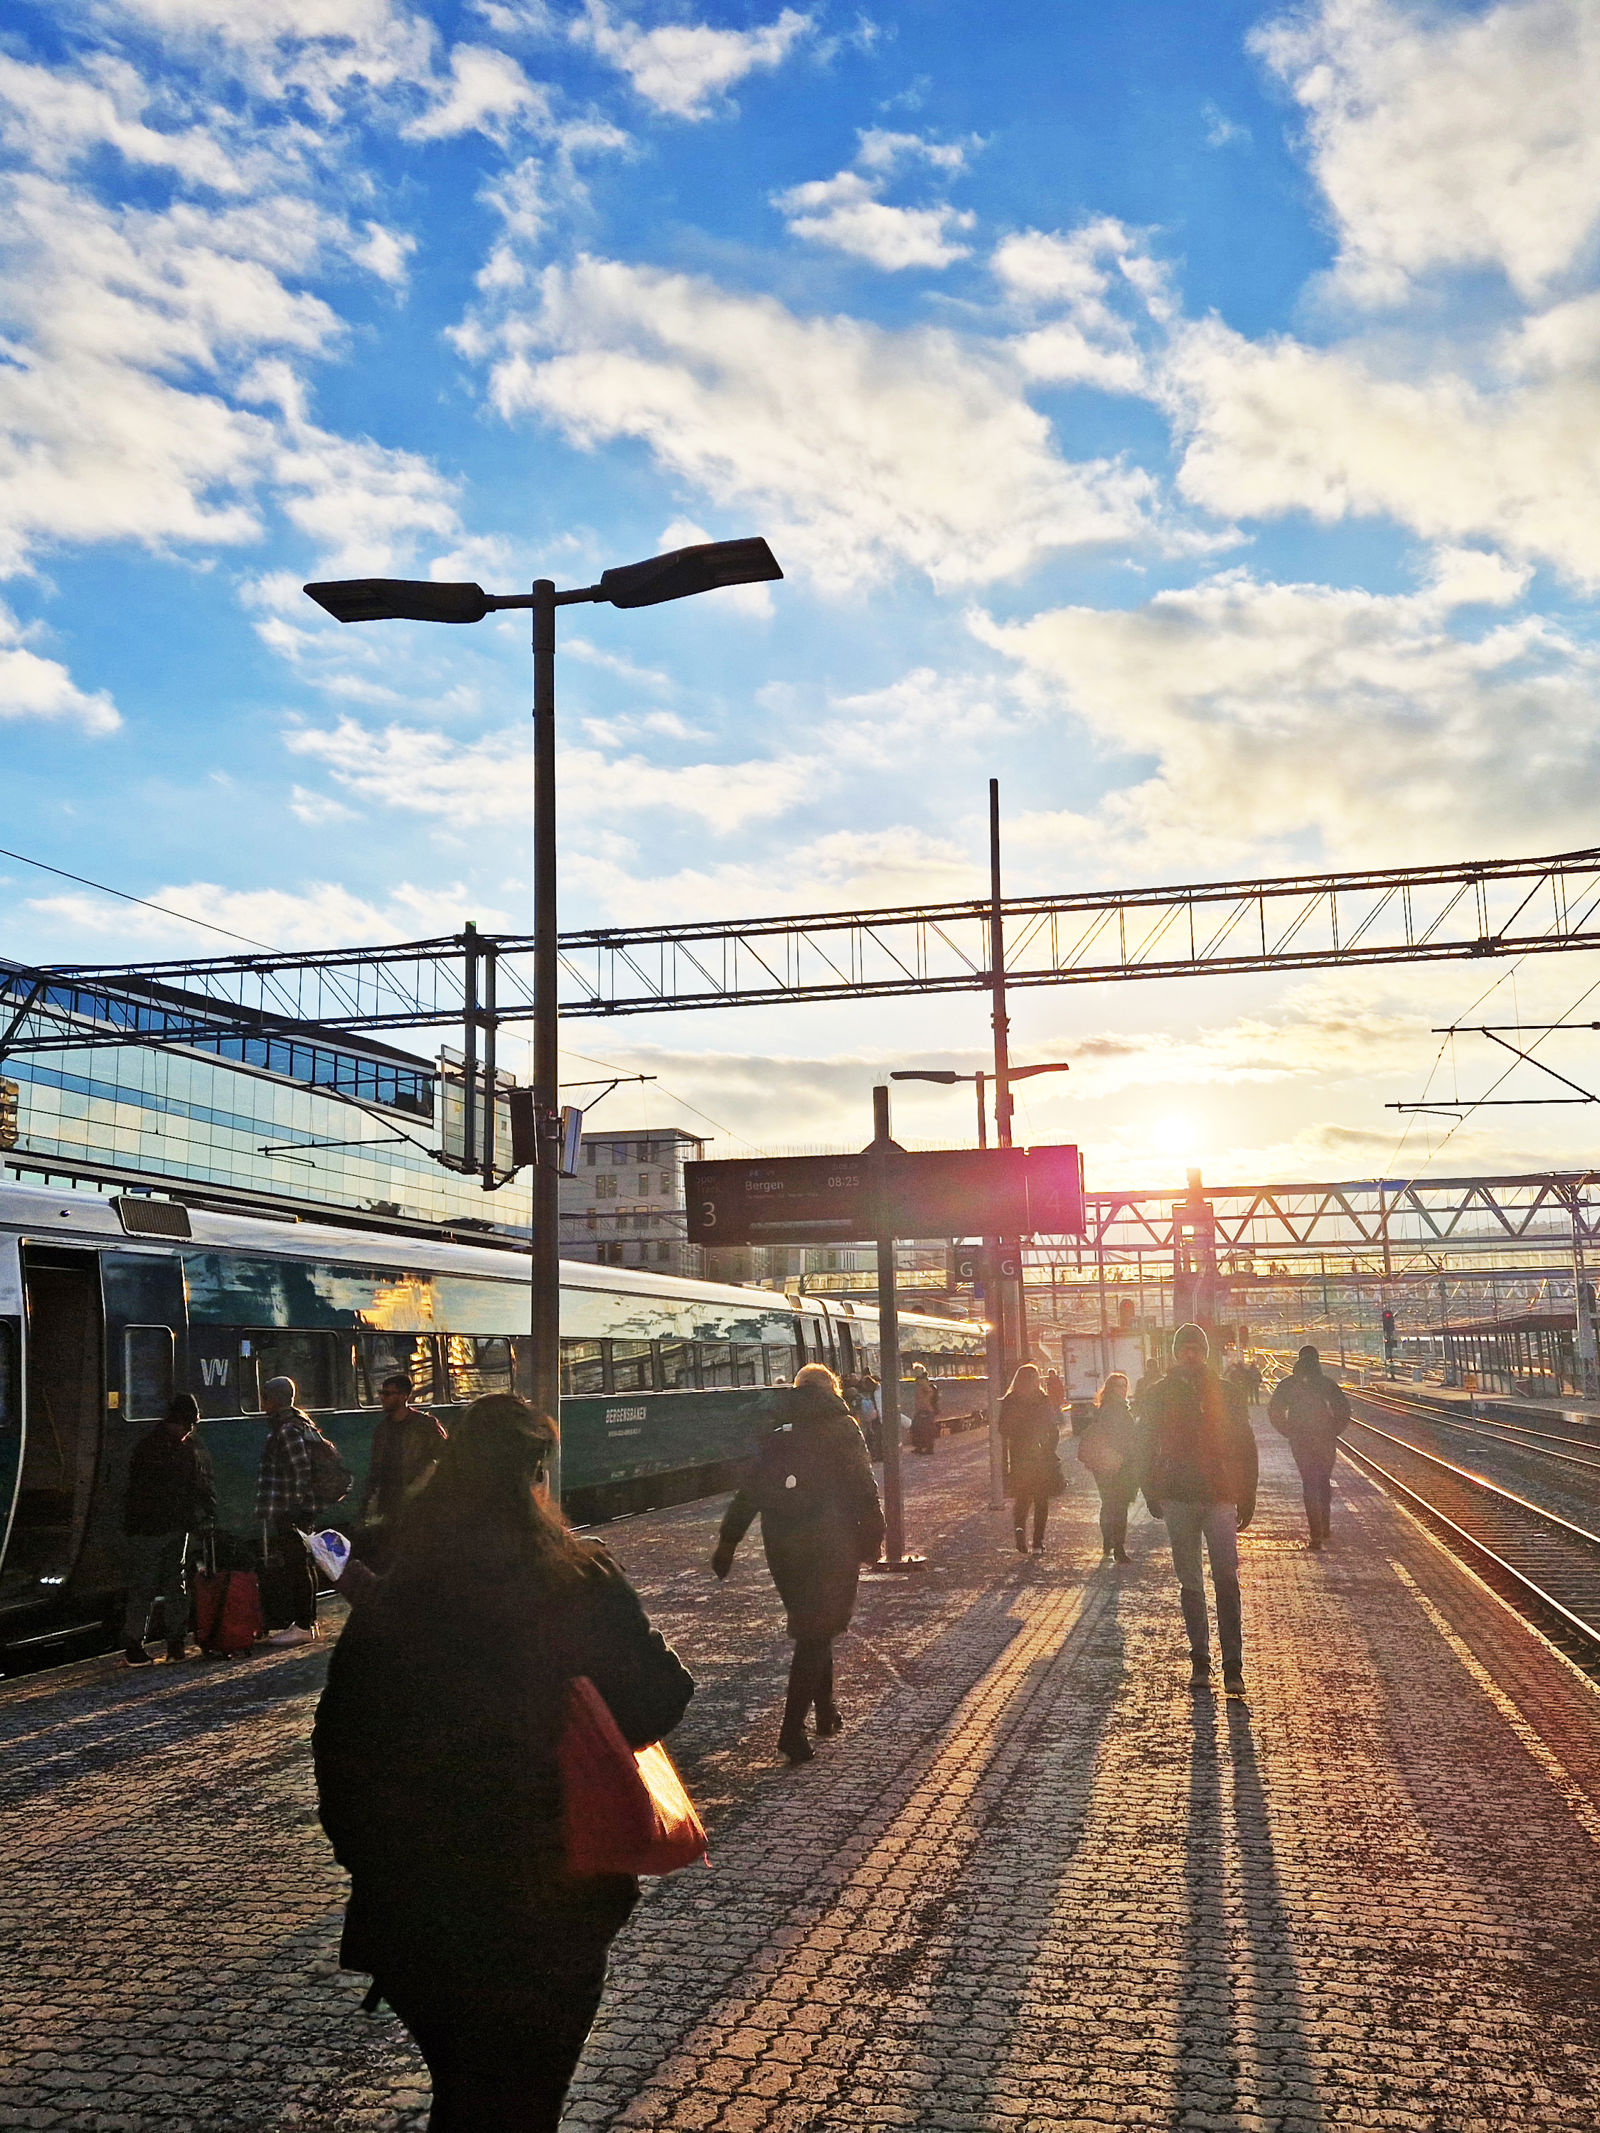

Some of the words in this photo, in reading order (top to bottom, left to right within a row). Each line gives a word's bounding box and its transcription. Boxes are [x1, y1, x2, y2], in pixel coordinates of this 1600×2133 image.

[745, 1180, 784, 1192] Bergen
[828, 1176, 860, 1187] 08:25
[702, 1201, 716, 1227] 3
[960, 1261, 973, 1278] G
[1001, 1259, 1015, 1276] G
